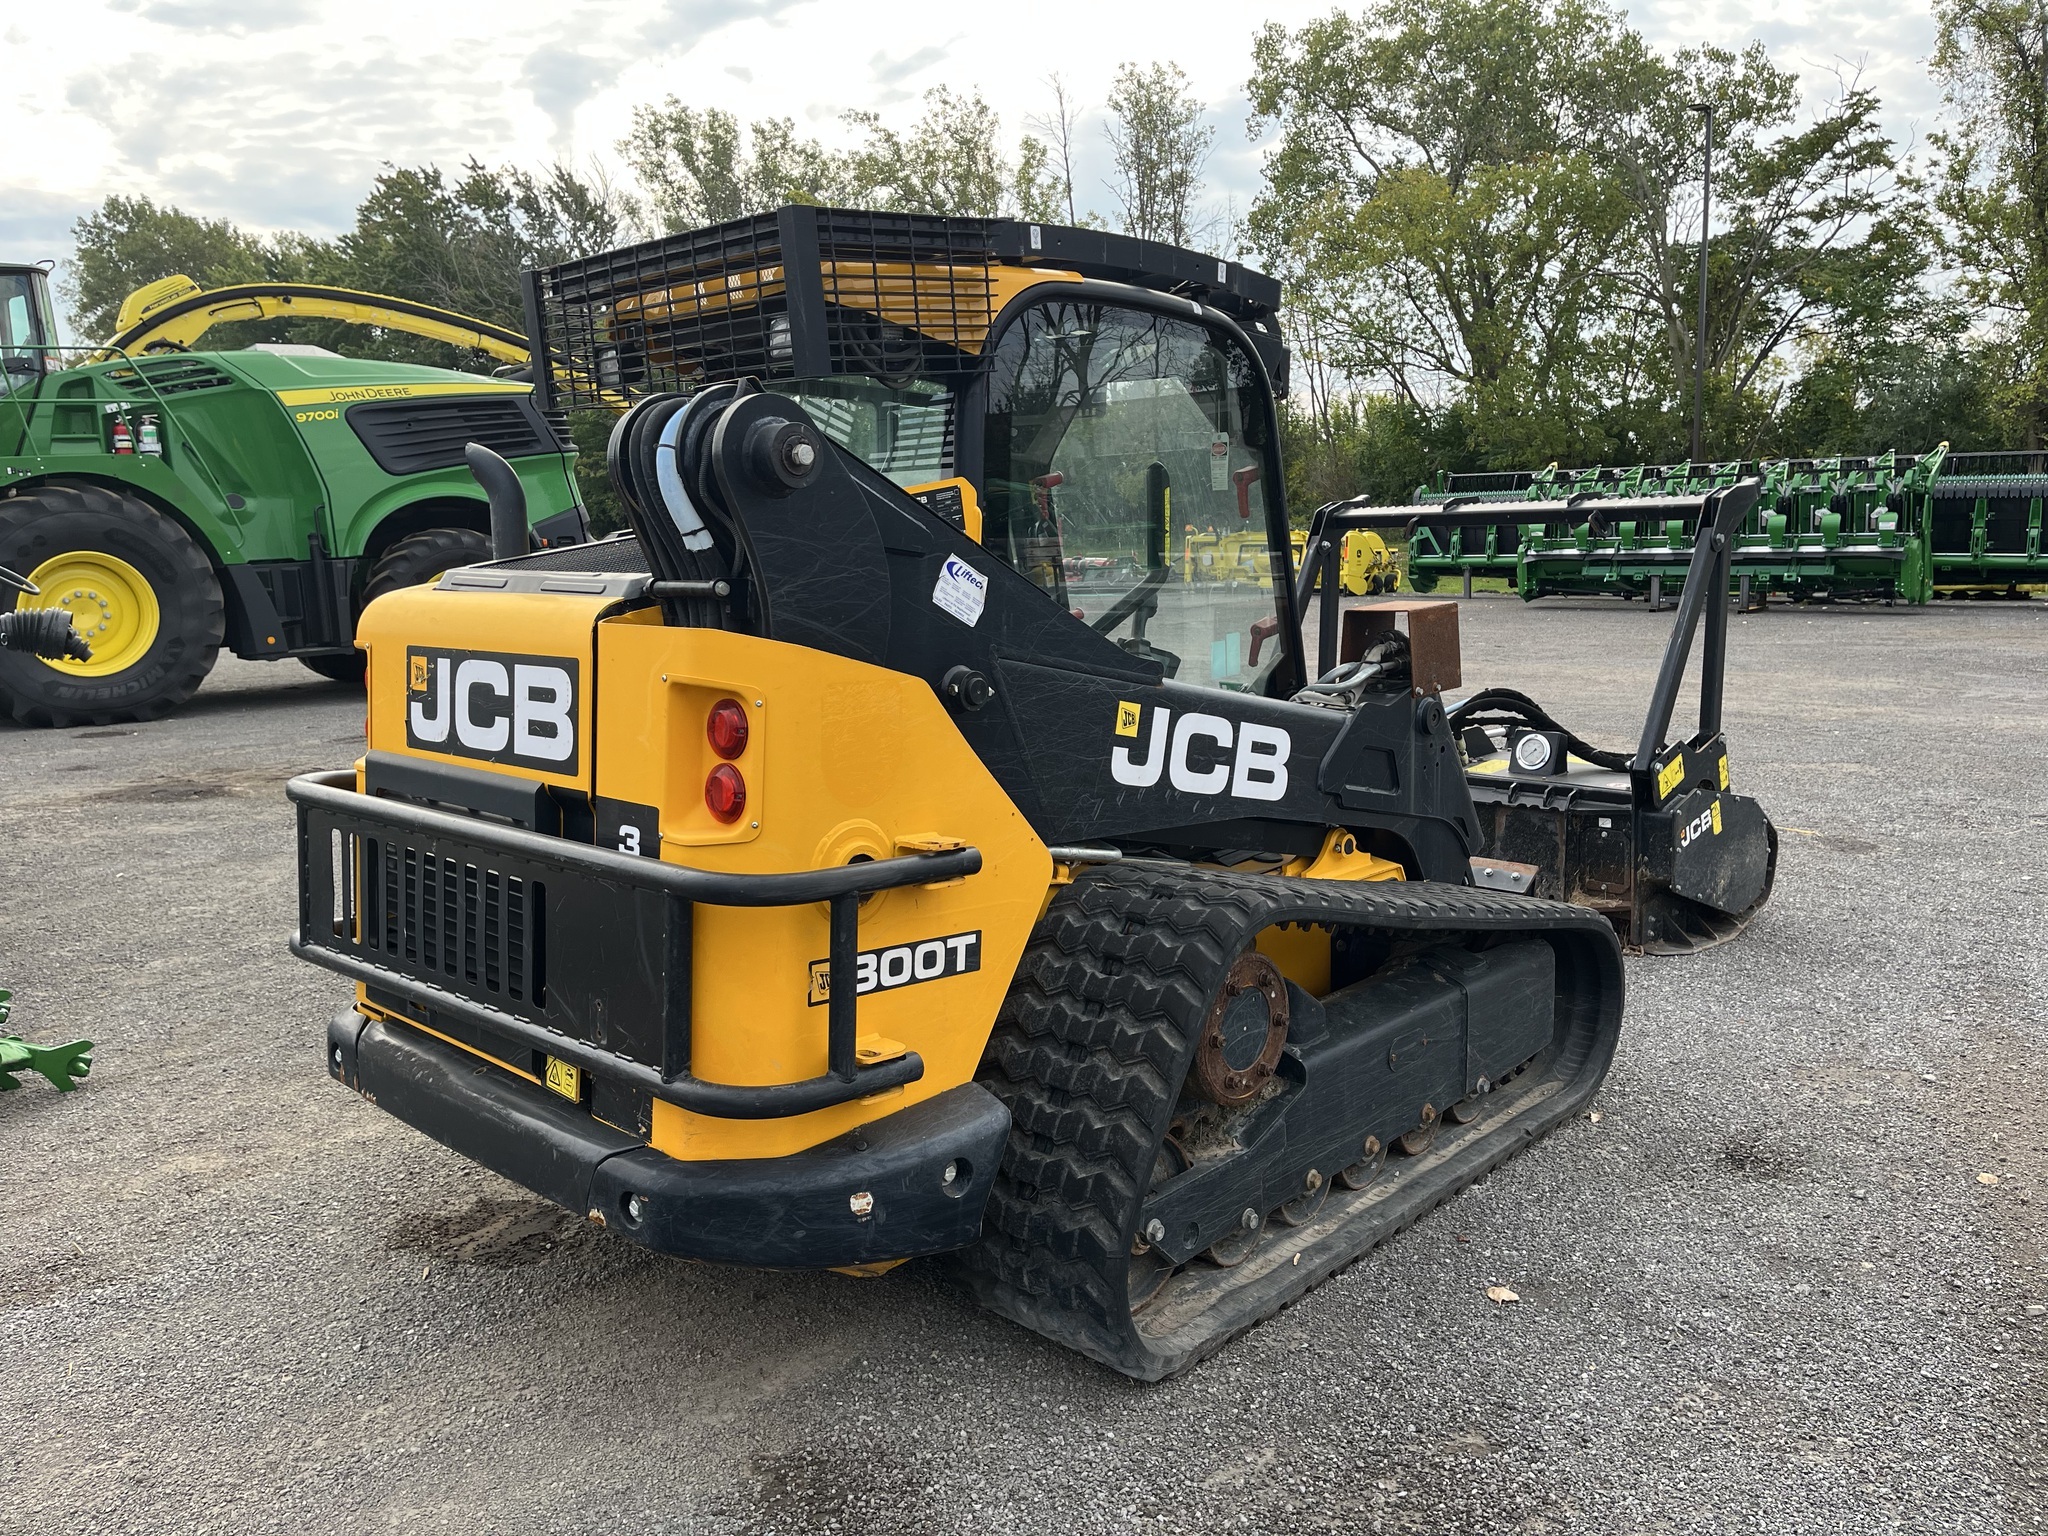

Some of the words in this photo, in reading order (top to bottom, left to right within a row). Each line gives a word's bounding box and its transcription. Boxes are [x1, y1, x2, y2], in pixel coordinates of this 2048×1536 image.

[329, 389, 365, 402] JOHN
[365, 387, 412, 398] DEERE
[296, 408, 339, 423] 9700i
[53, 664, 166, 700] MICHELIN
[410, 657, 574, 762] JCB
[1122, 710, 1136, 727] JCB
[1111, 706, 1291, 801] JCB
[618, 824, 640, 856] 3
[1681, 808, 1712, 847] JCB
[819, 973, 830, 990] JC
